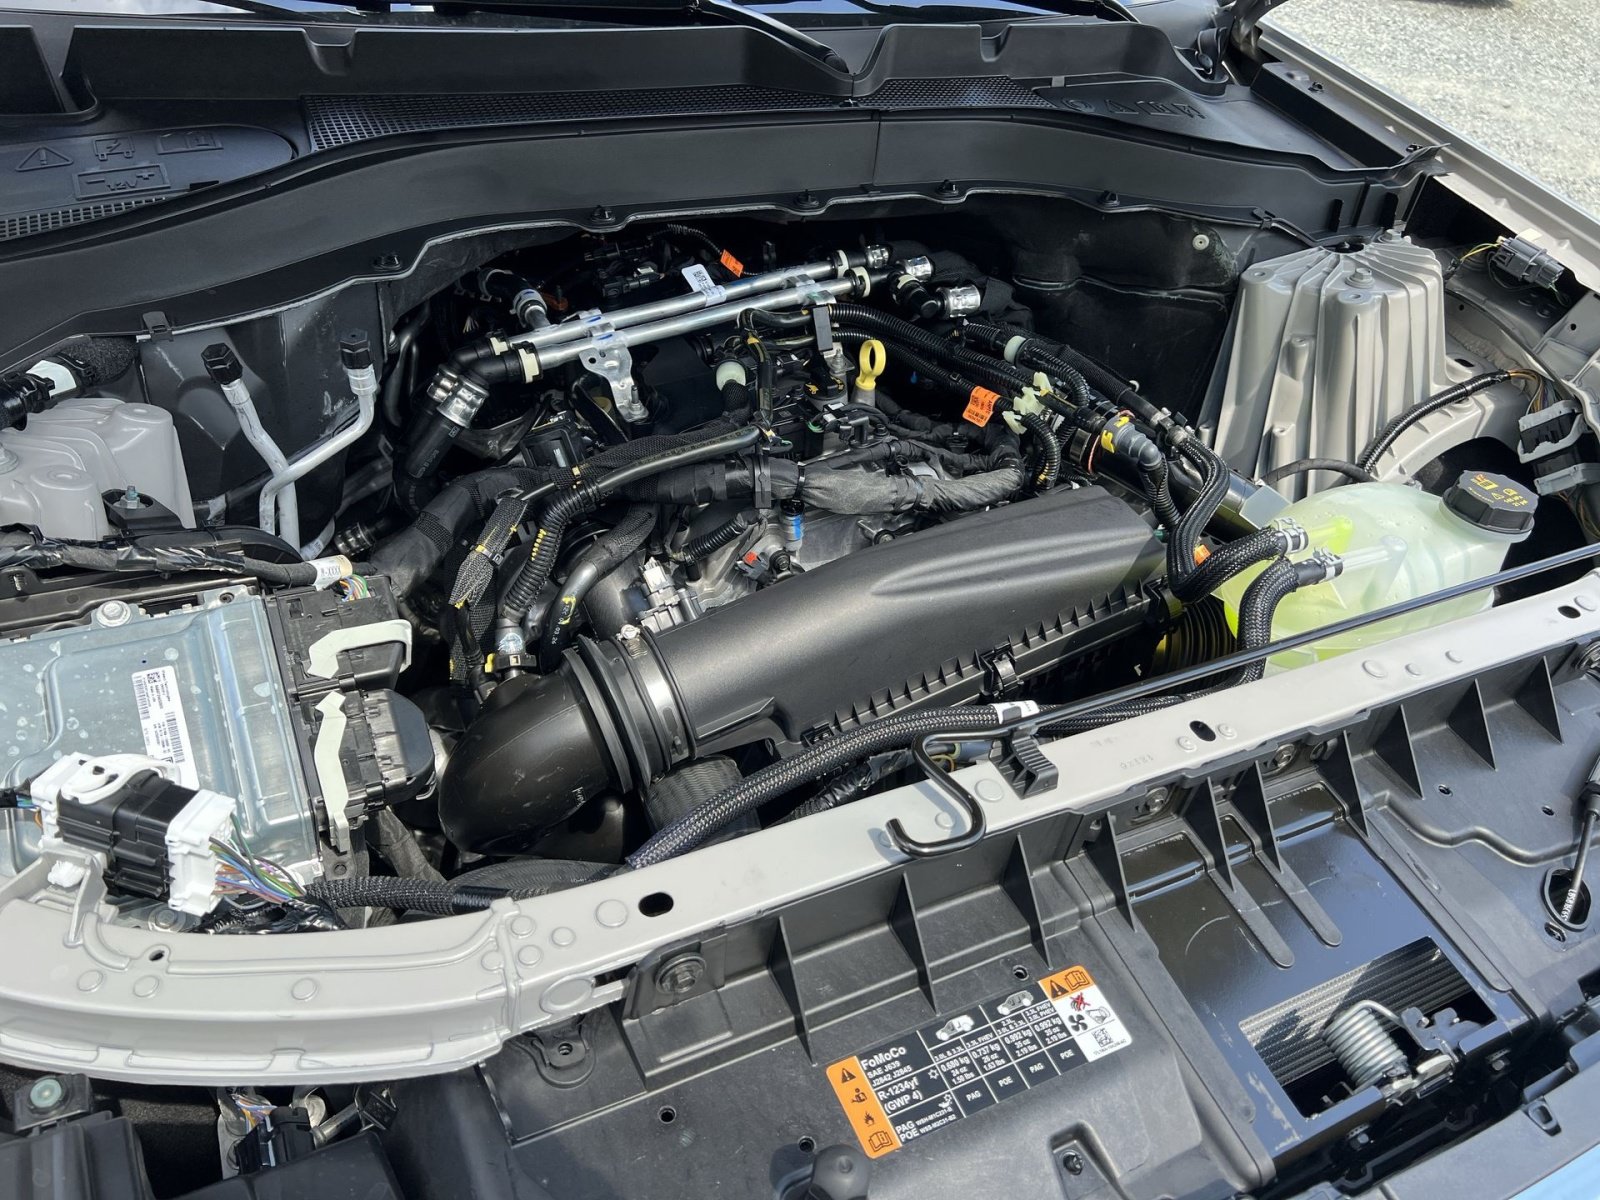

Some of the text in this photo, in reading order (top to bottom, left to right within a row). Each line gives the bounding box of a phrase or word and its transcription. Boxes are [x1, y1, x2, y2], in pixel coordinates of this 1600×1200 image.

[1036, 1002, 1051, 1012] FHEV
[1034, 1020, 1052, 1032] 0.992
[978, 1032, 994, 1042] FHEV
[1004, 1029, 1033, 1044] 0.992 kg
[1014, 1040, 1023, 1048] 35
[972, 1043, 1001, 1058] 0.737 kg
[1016, 1047, 1028, 1057] 2.19
[1060, 1049, 1075, 1059] POE
[861, 1047, 907, 1070] FoMoCo
[941, 1056, 970, 1072] 0.680 kg
[867, 1061, 900, 1079] SAE J639
[983, 1062, 996, 1071] 1.63
[1029, 1062, 1045, 1073] PAG
[873, 1065, 912, 1087] J2842 J2845
[952, 1075, 965, 1085] 1.50
[998, 1076, 1014, 1087] POE
[878, 1077, 919, 1100] R-1234yf
[966, 1090, 982, 1101] PAG
[884, 1090, 923, 1114] (GWP 4)
[895, 1121, 915, 1134] PAG
[900, 1128, 919, 1142] POE
